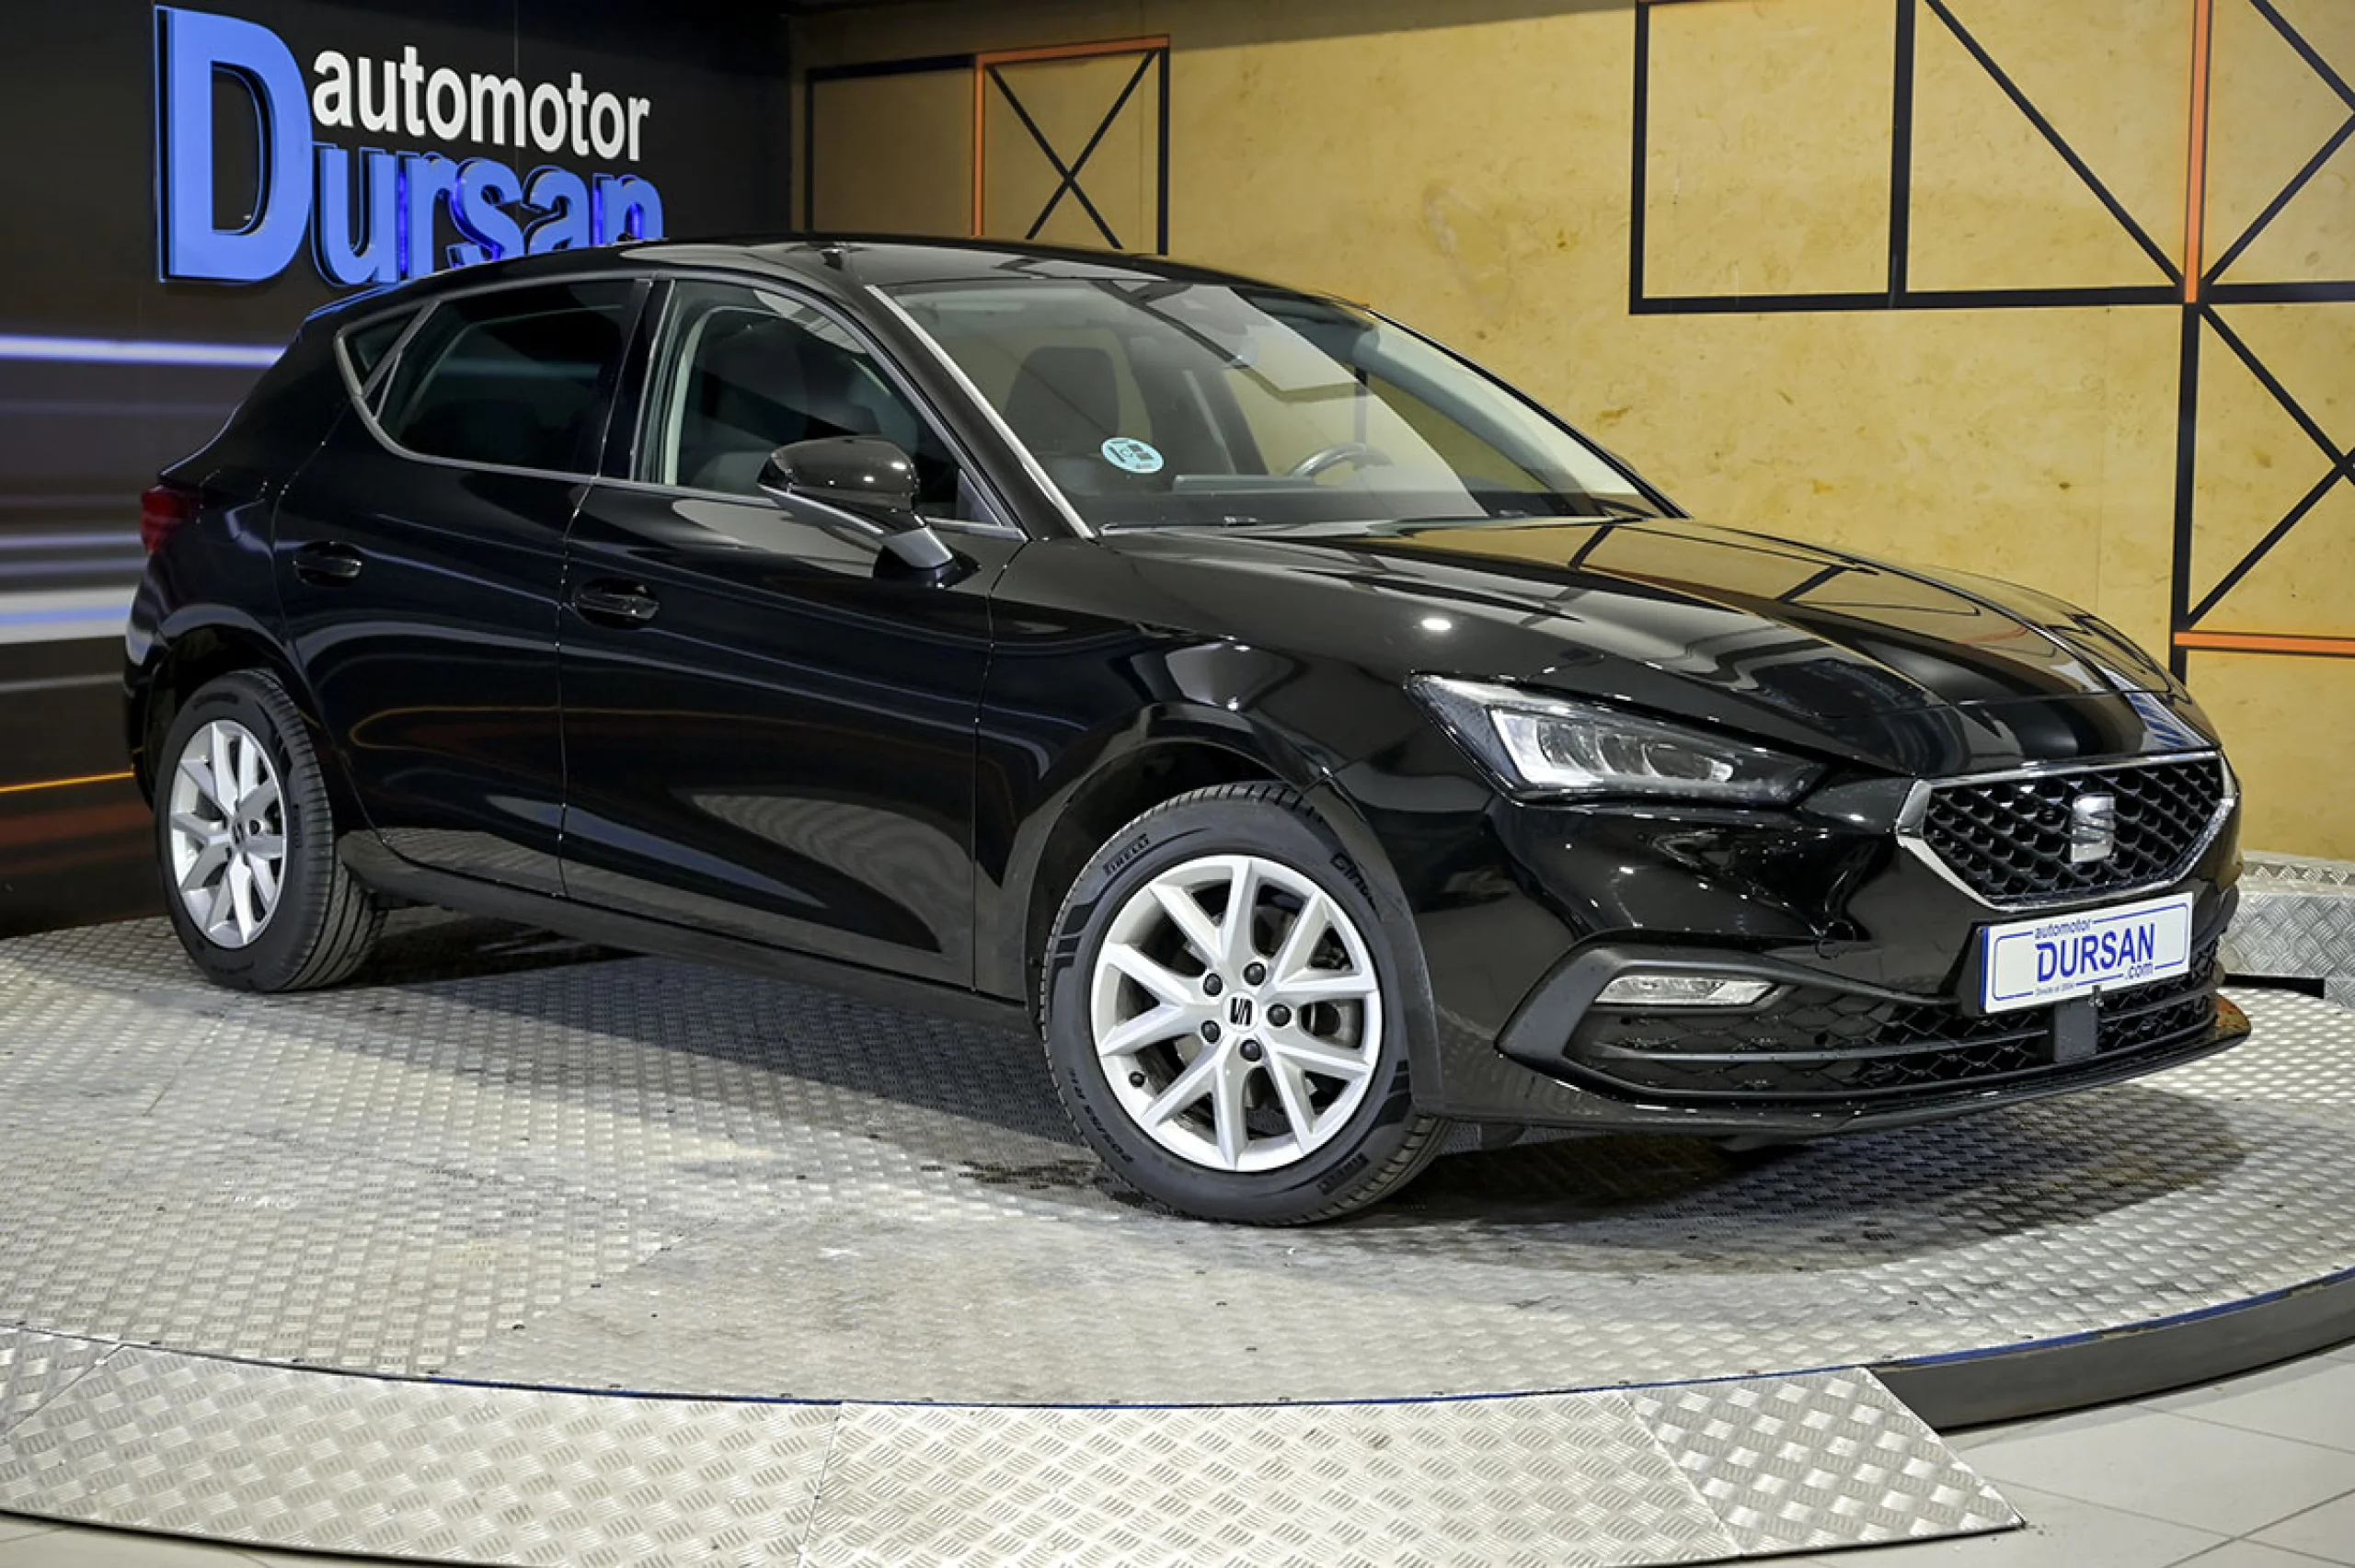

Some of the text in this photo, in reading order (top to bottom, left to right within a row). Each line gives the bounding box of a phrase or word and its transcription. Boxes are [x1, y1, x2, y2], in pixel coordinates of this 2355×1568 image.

[312, 46, 651, 162] automotor
[2035, 919, 2091, 939] automotor
[2035, 922, 2155, 983] DURSAN
[2126, 963, 2154, 980] .com
